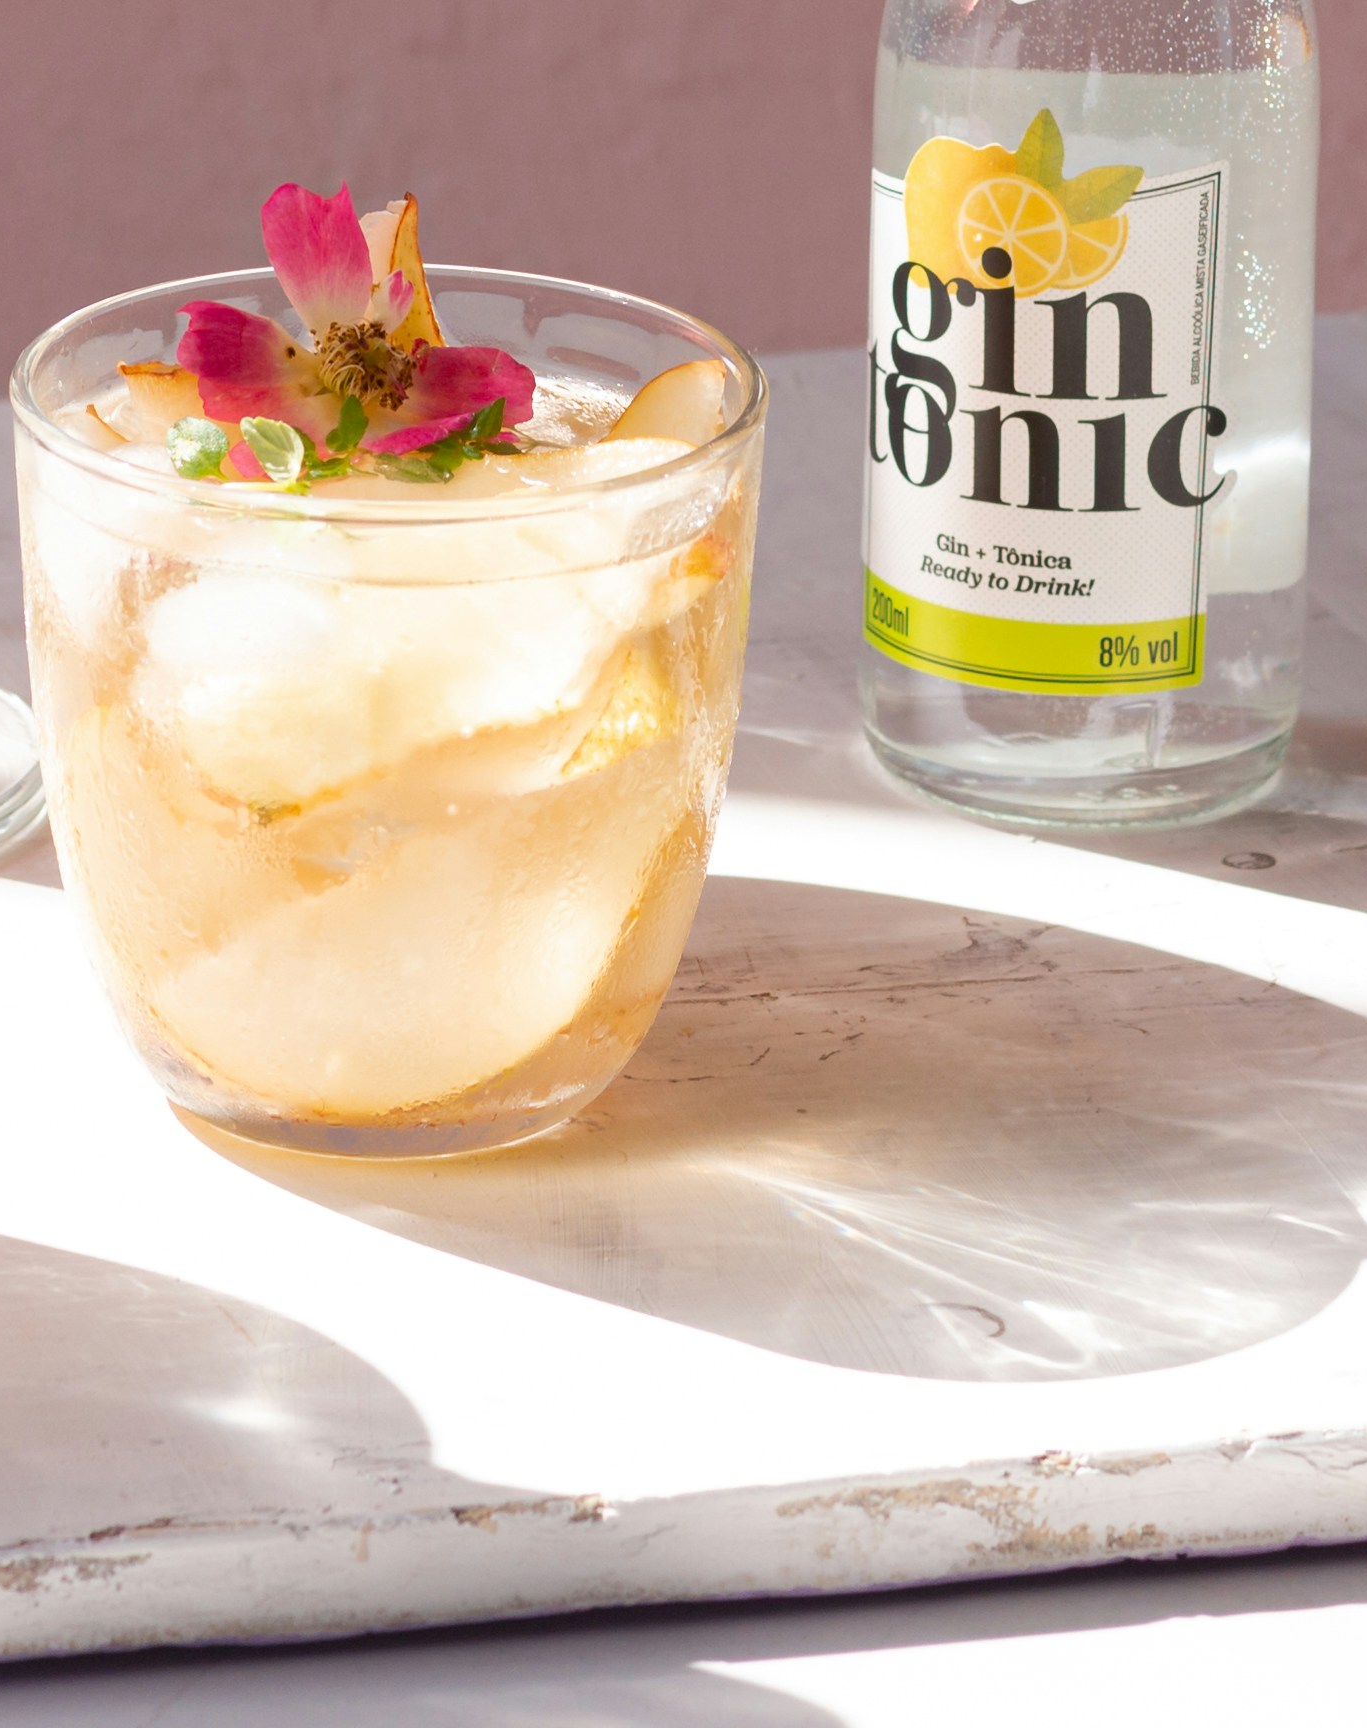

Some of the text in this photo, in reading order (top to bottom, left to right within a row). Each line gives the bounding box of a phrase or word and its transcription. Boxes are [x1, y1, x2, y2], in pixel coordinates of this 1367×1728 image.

[1197, 191, 1210, 256] GASEIFICADA
[1196, 258, 1206, 290] MISTA
[888, 246, 1168, 430] gin
[1190, 350, 1201, 386] BEBIDA
[868, 337, 1229, 512] tonic
[936, 533, 1072, 570] Gin + Tônica
[920, 555, 1095, 597] Ready to Drink!
[872, 588, 909, 637] 200ml
[1099, 631, 1178, 668] 8% vol
